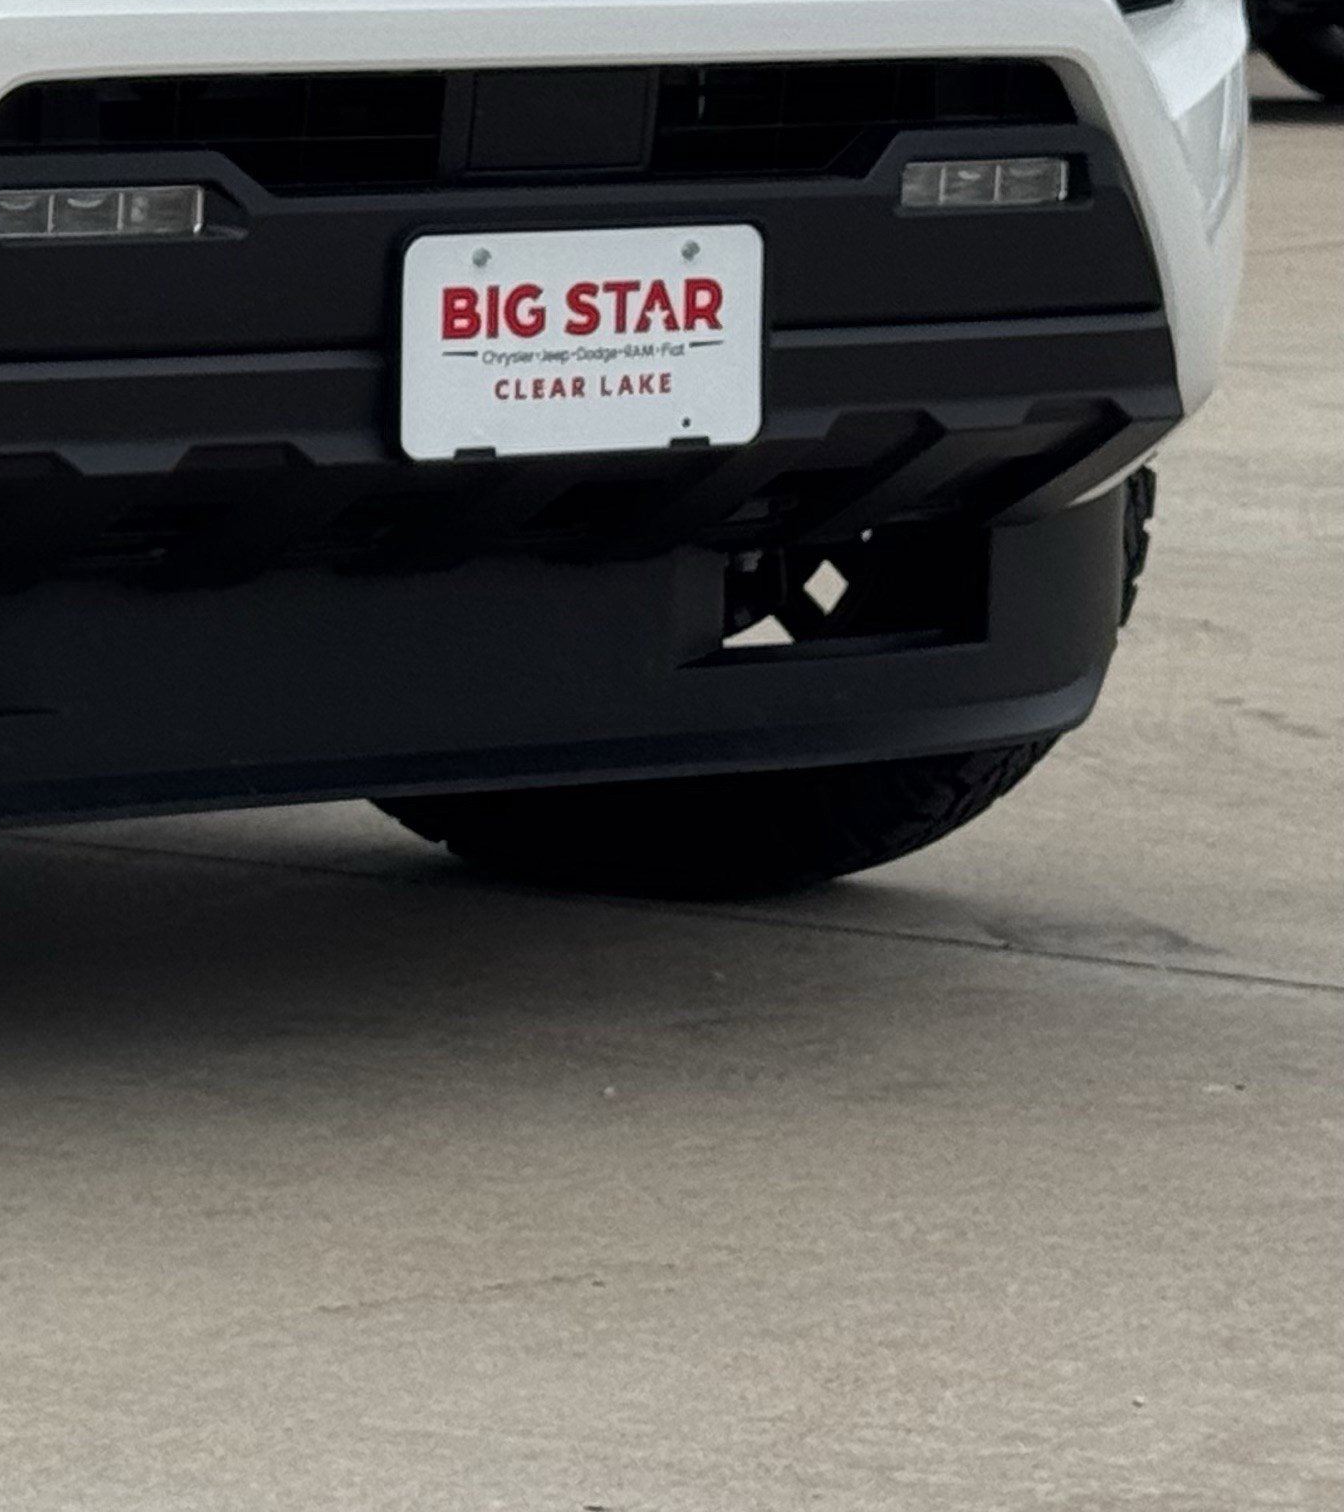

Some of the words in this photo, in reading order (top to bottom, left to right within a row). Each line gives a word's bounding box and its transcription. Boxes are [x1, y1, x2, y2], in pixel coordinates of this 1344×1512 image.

[442, 284, 546, 339] BIG
[564, 278, 723, 336] STAR
[494, 376, 586, 400] CLEAR
[600, 372, 672, 396] LAKE
